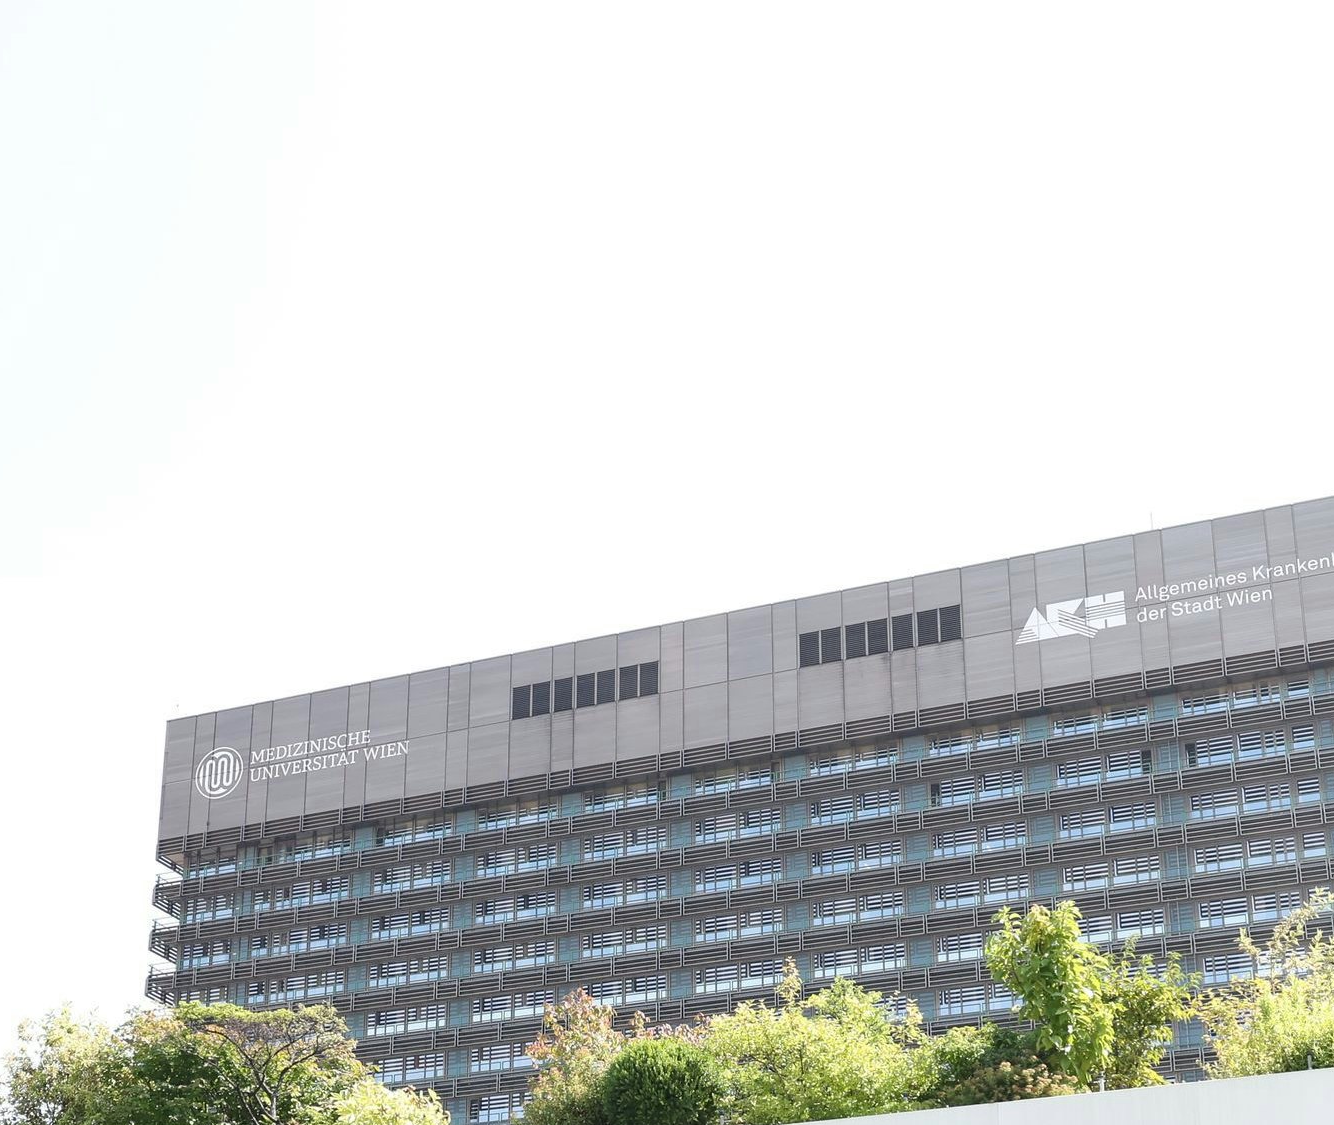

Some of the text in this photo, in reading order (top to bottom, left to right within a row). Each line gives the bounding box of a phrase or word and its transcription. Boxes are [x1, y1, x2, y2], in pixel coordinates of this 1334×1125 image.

[1134, 570, 1248, 603] Allgemeines
[1136, 587, 1274, 624] der Stadt Wien
[250, 730, 371, 764] MEDIZINISCHE
[250, 741, 410, 783] UNIVERSITÄT WIEN
